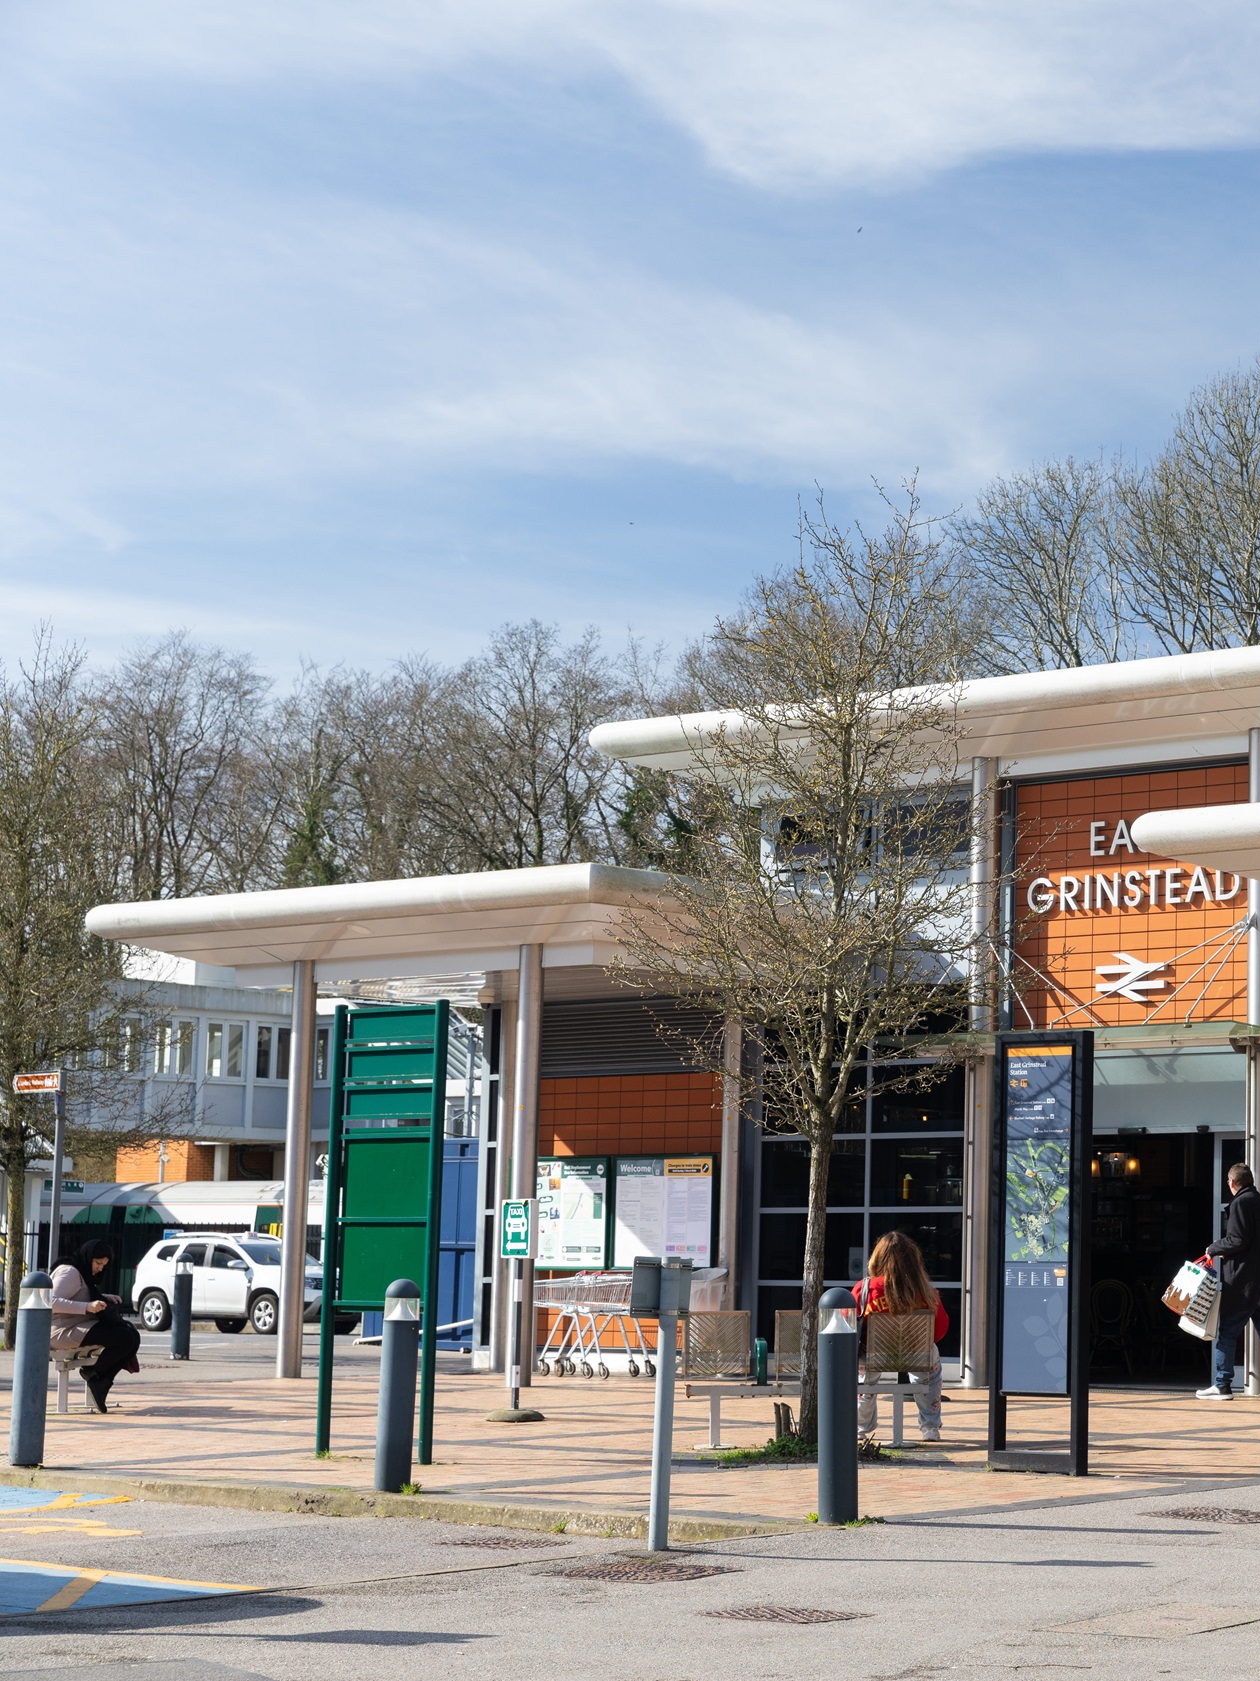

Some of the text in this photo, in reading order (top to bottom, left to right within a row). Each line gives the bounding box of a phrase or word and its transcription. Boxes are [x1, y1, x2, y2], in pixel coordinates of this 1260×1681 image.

[1090, 819, 1149, 857] EA
[1027, 866, 1243, 914] GRINSTEAD
[620, 1163, 652, 1173] Welcome
[510, 1207, 523, 1216] TAXI
